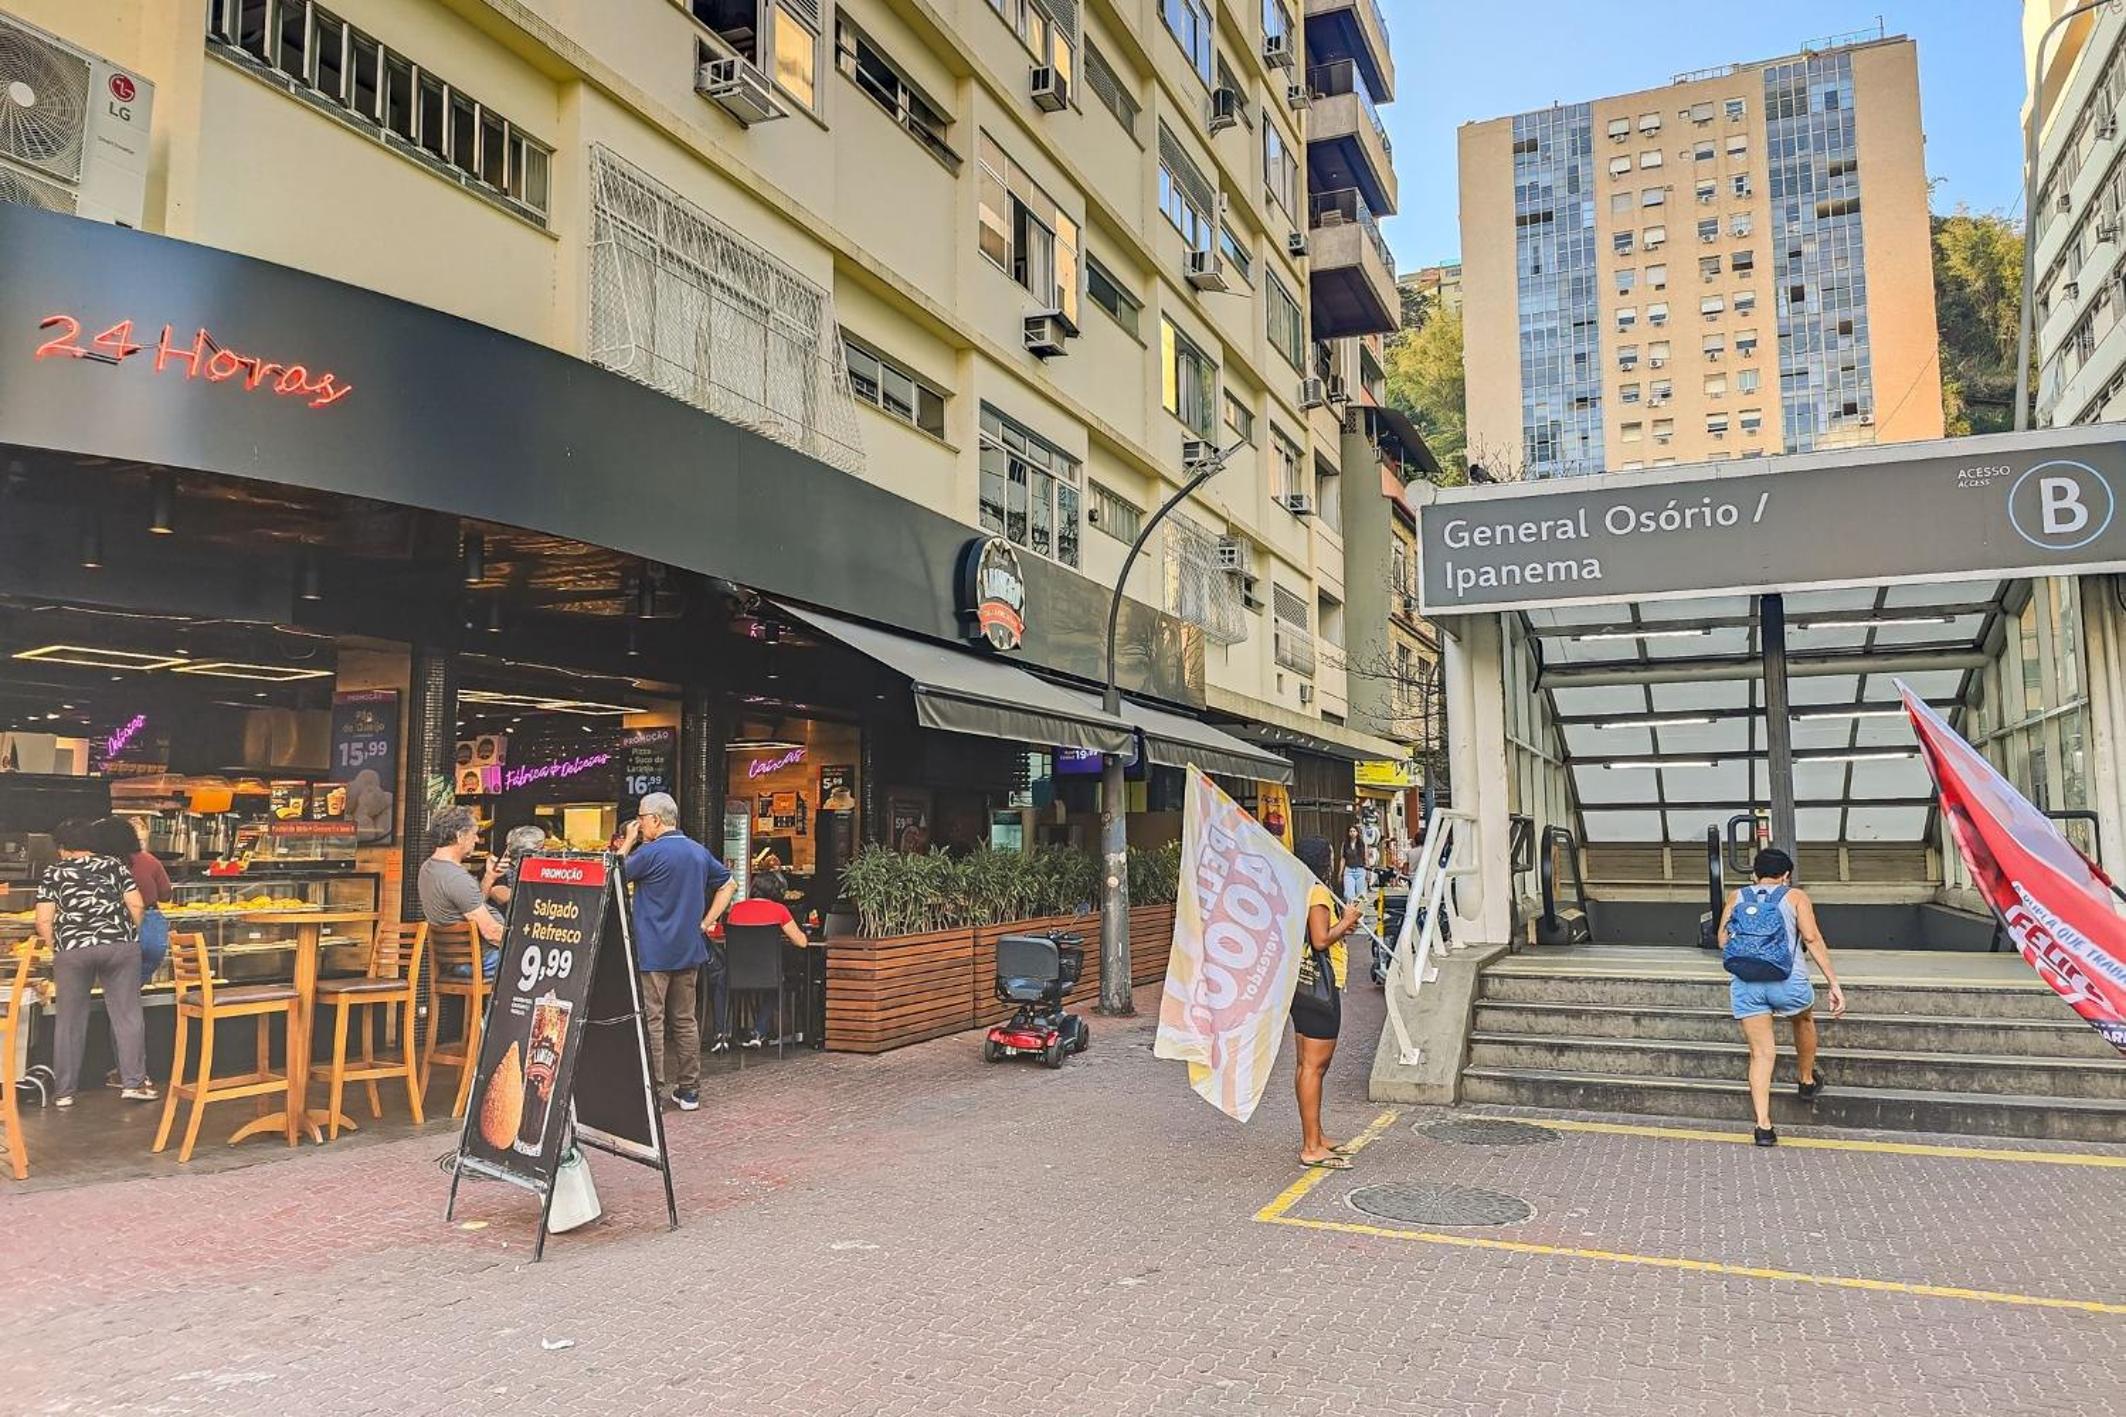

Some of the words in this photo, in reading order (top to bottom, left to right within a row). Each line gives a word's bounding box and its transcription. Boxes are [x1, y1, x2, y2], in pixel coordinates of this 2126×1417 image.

[109, 101, 131, 121] LG
[36, 315, 141, 363] 24
[154, 322, 352, 407] Horas
[1958, 466, 2011, 479] ACESSO
[2040, 477, 2089, 534] B
[1443, 508, 1590, 549] General
[1604, 497, 1739, 536] Osório
[1445, 556, 1602, 597] Ipanema
[339, 741, 388, 767] 15,99
[749, 749, 807, 778] Caixas
[626, 776, 662, 795] 16,99
[541, 867, 583, 881] PROMOÇÃO
[533, 898, 579, 920] Salgado
[523, 924, 531, 935] +
[532, 922, 582, 944] Refresco
[2057, 927, 2086, 951] QUE
[517, 945, 573, 992] 9,99
